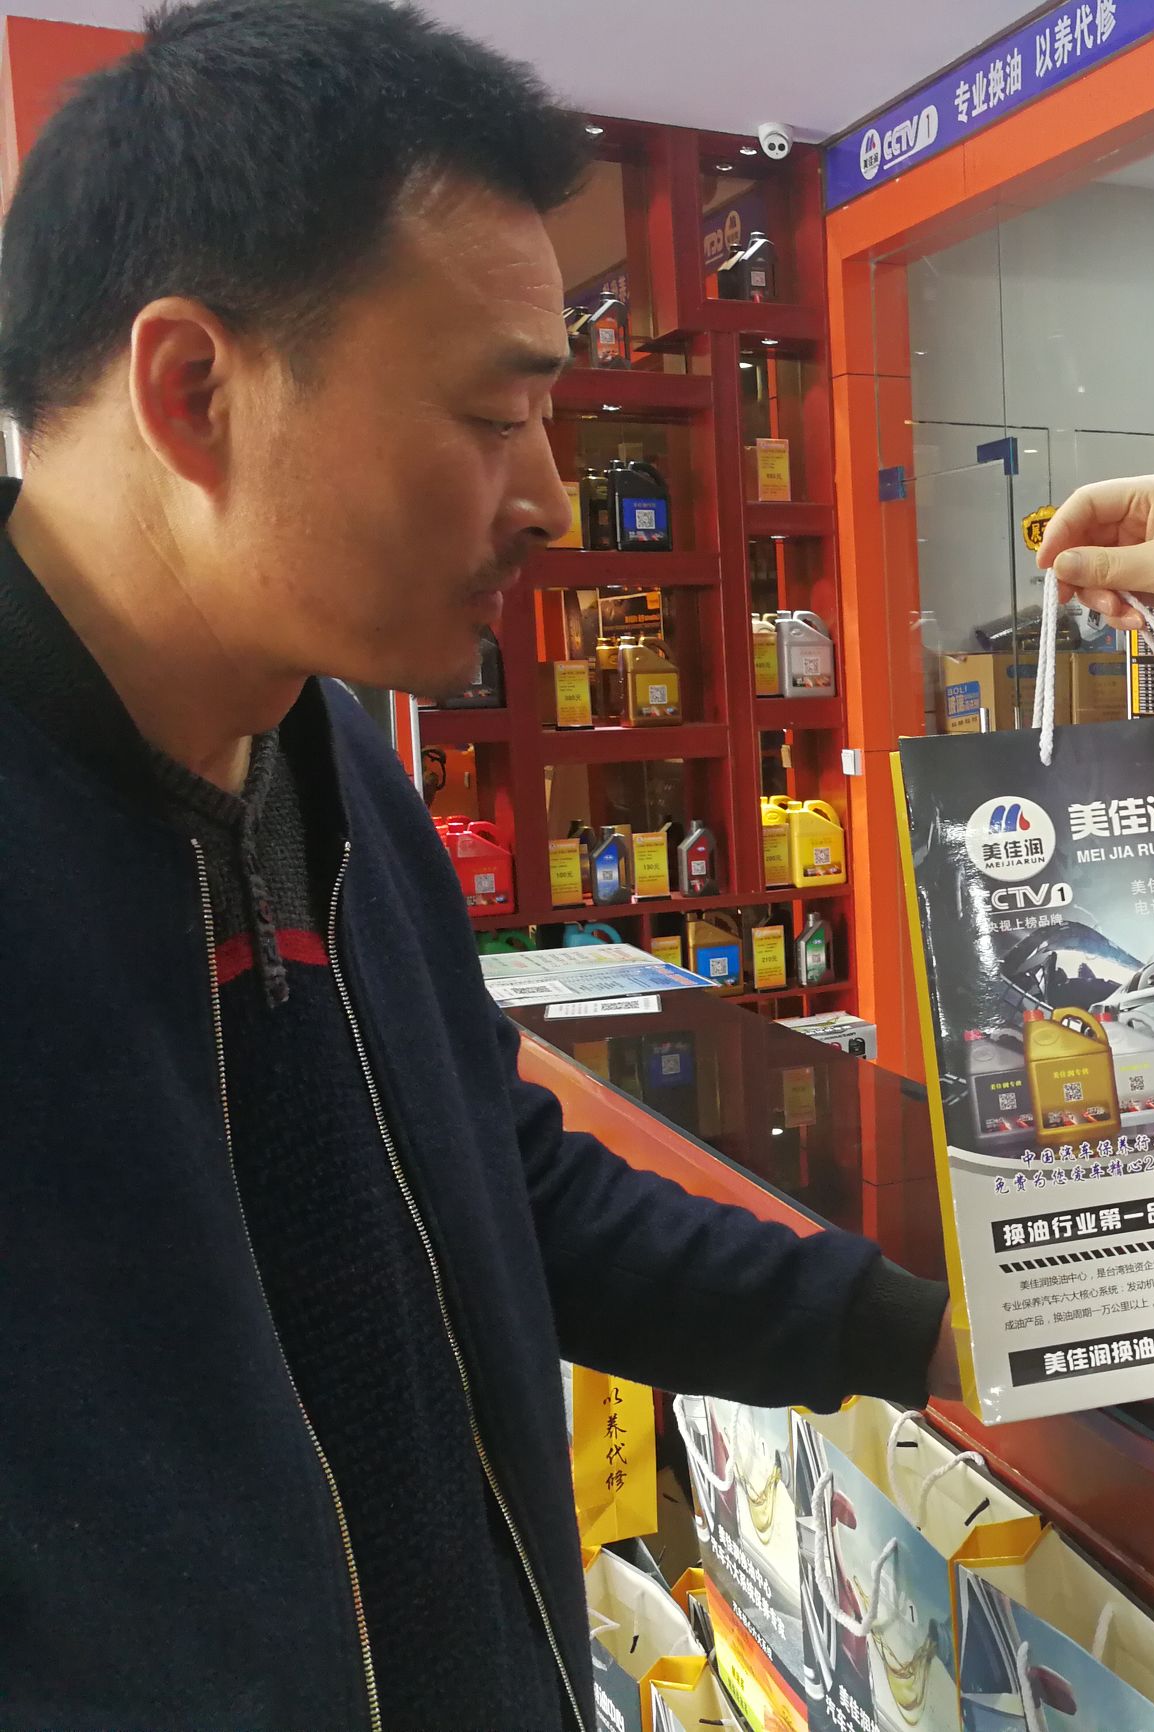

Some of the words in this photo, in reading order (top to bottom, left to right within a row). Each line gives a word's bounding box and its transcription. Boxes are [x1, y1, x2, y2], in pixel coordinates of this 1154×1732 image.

[954, 47, 1022, 123] 专业换油
[1035, 0, 1117, 77] 以养代修
[982, 838, 1044, 861] 美佳润
[1076, 849, 1106, 863] MEI
[1109, 846, 1134, 860] JIA
[985, 857, 1045, 869] MEIJIARUN
[988, 914, 1064, 933] 央视上榜品牌
[603, 1387, 627, 1492] 以养代修
